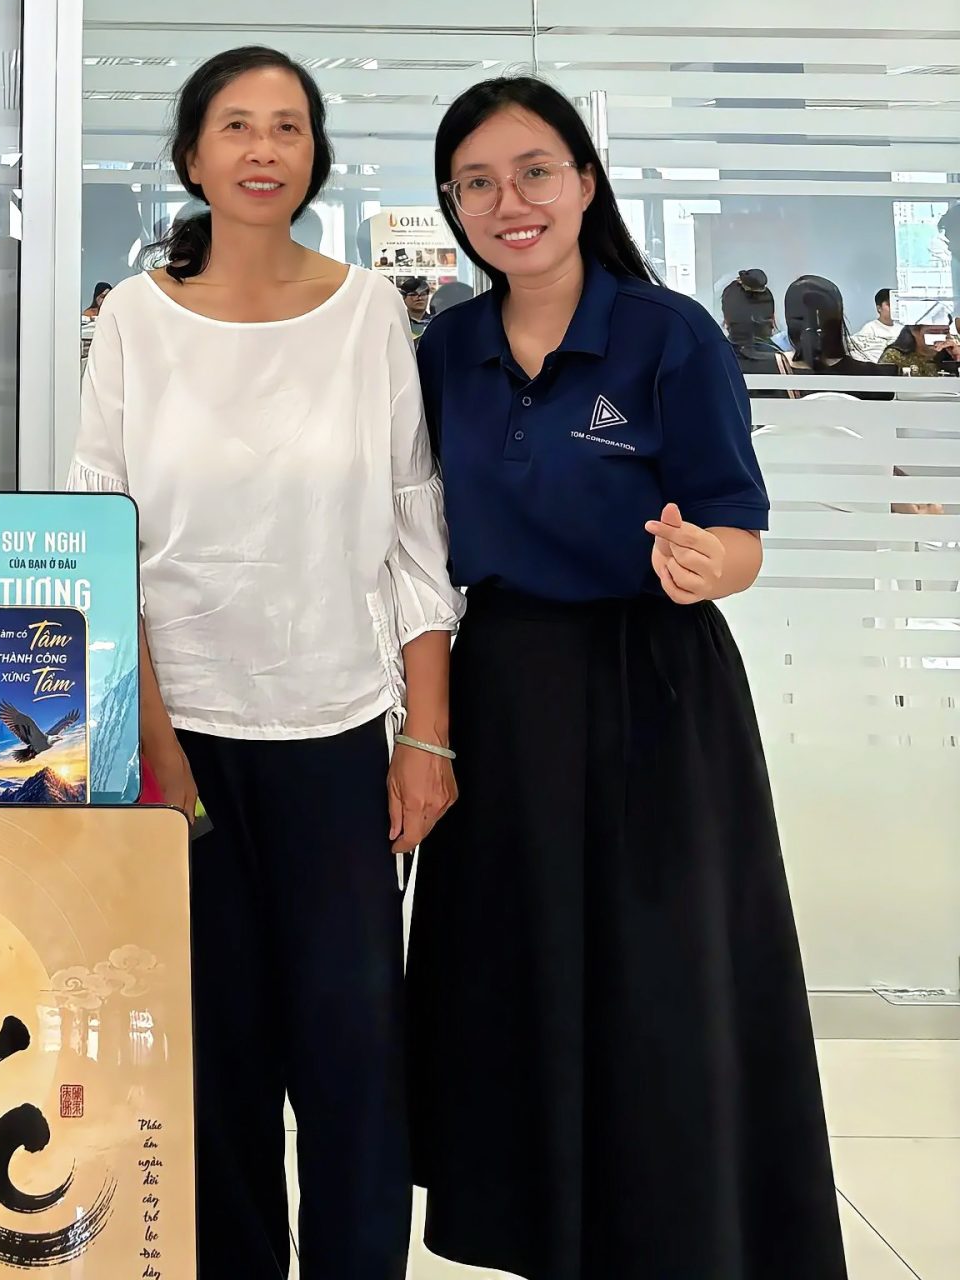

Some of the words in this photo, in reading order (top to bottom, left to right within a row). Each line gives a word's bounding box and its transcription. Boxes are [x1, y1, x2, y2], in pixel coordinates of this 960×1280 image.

[585, 434, 636, 452] CORPORATION
[1, 530, 37, 553] SUY
[9, 557, 26, 569] CỦA
[28, 559, 47, 570] BẠN
[58, 559, 77, 569] ĐÂU
[16, 629, 28, 638] có
[28, 620, 72, 651] Tâm
[35, 652, 67, 664] CÔNG
[1, 671, 31, 682] XỨNG
